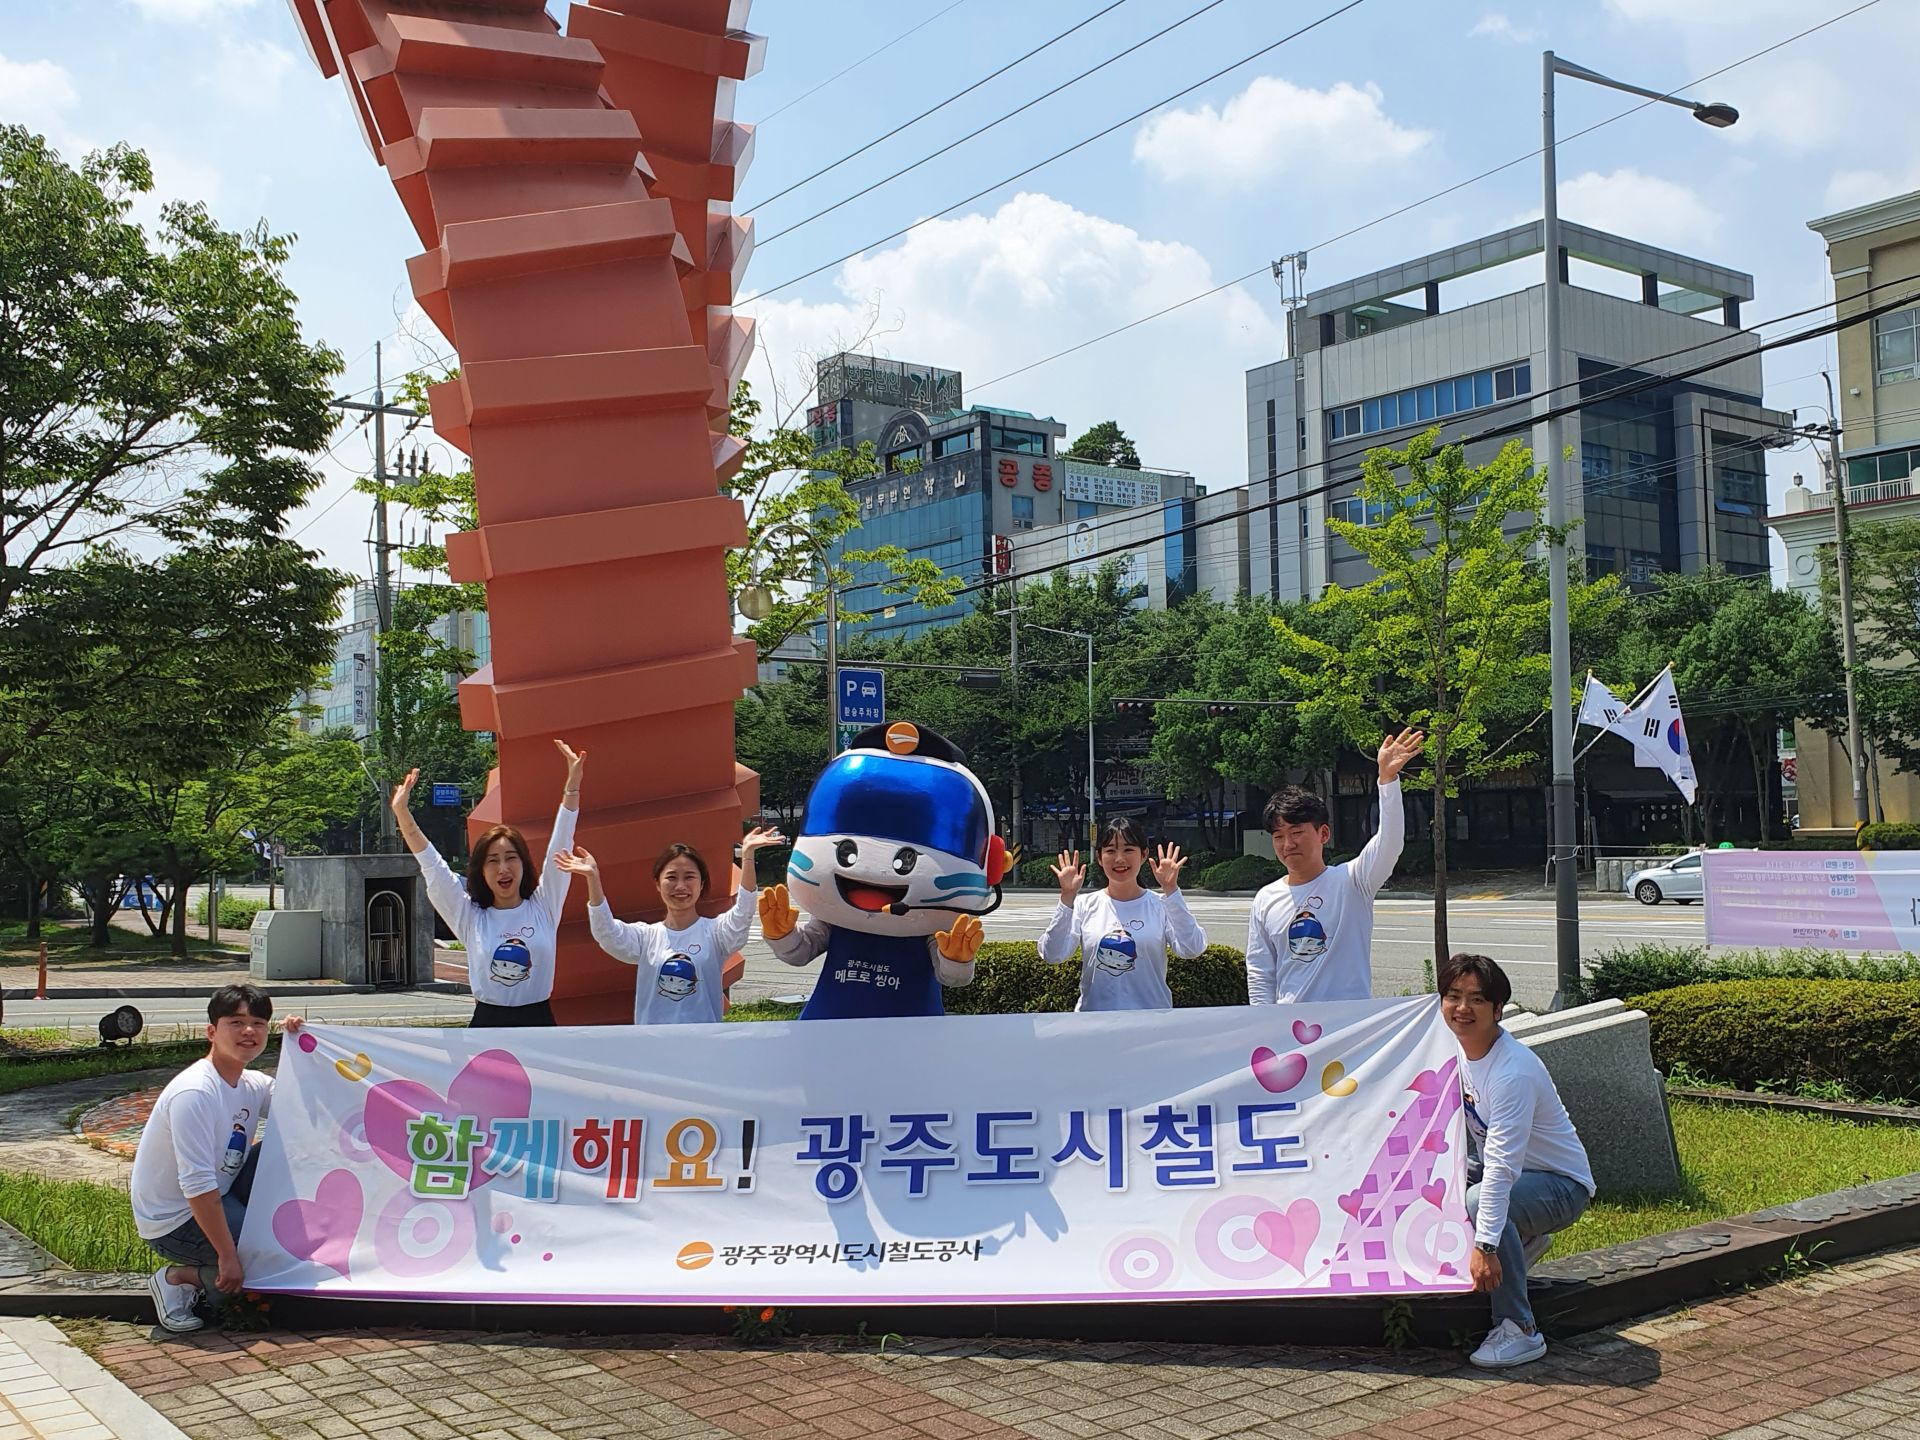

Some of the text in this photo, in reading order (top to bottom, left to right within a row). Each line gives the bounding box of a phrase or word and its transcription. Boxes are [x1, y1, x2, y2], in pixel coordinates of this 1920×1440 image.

[848, 367, 900, 394] 법무법인
[998, 459, 1053, 492] 공증
[865, 485, 911, 510] 법무법인
[846, 680, 857, 697] P
[844, 706, 880, 718] 환승주차장
[834, 969, 901, 990] 메트로 씽아
[406, 1113, 758, 1202] 함께해요!
[794, 1101, 1312, 1201] 광주도시철도
[719, 1239, 985, 1267] 광주광역시도시철도공사
